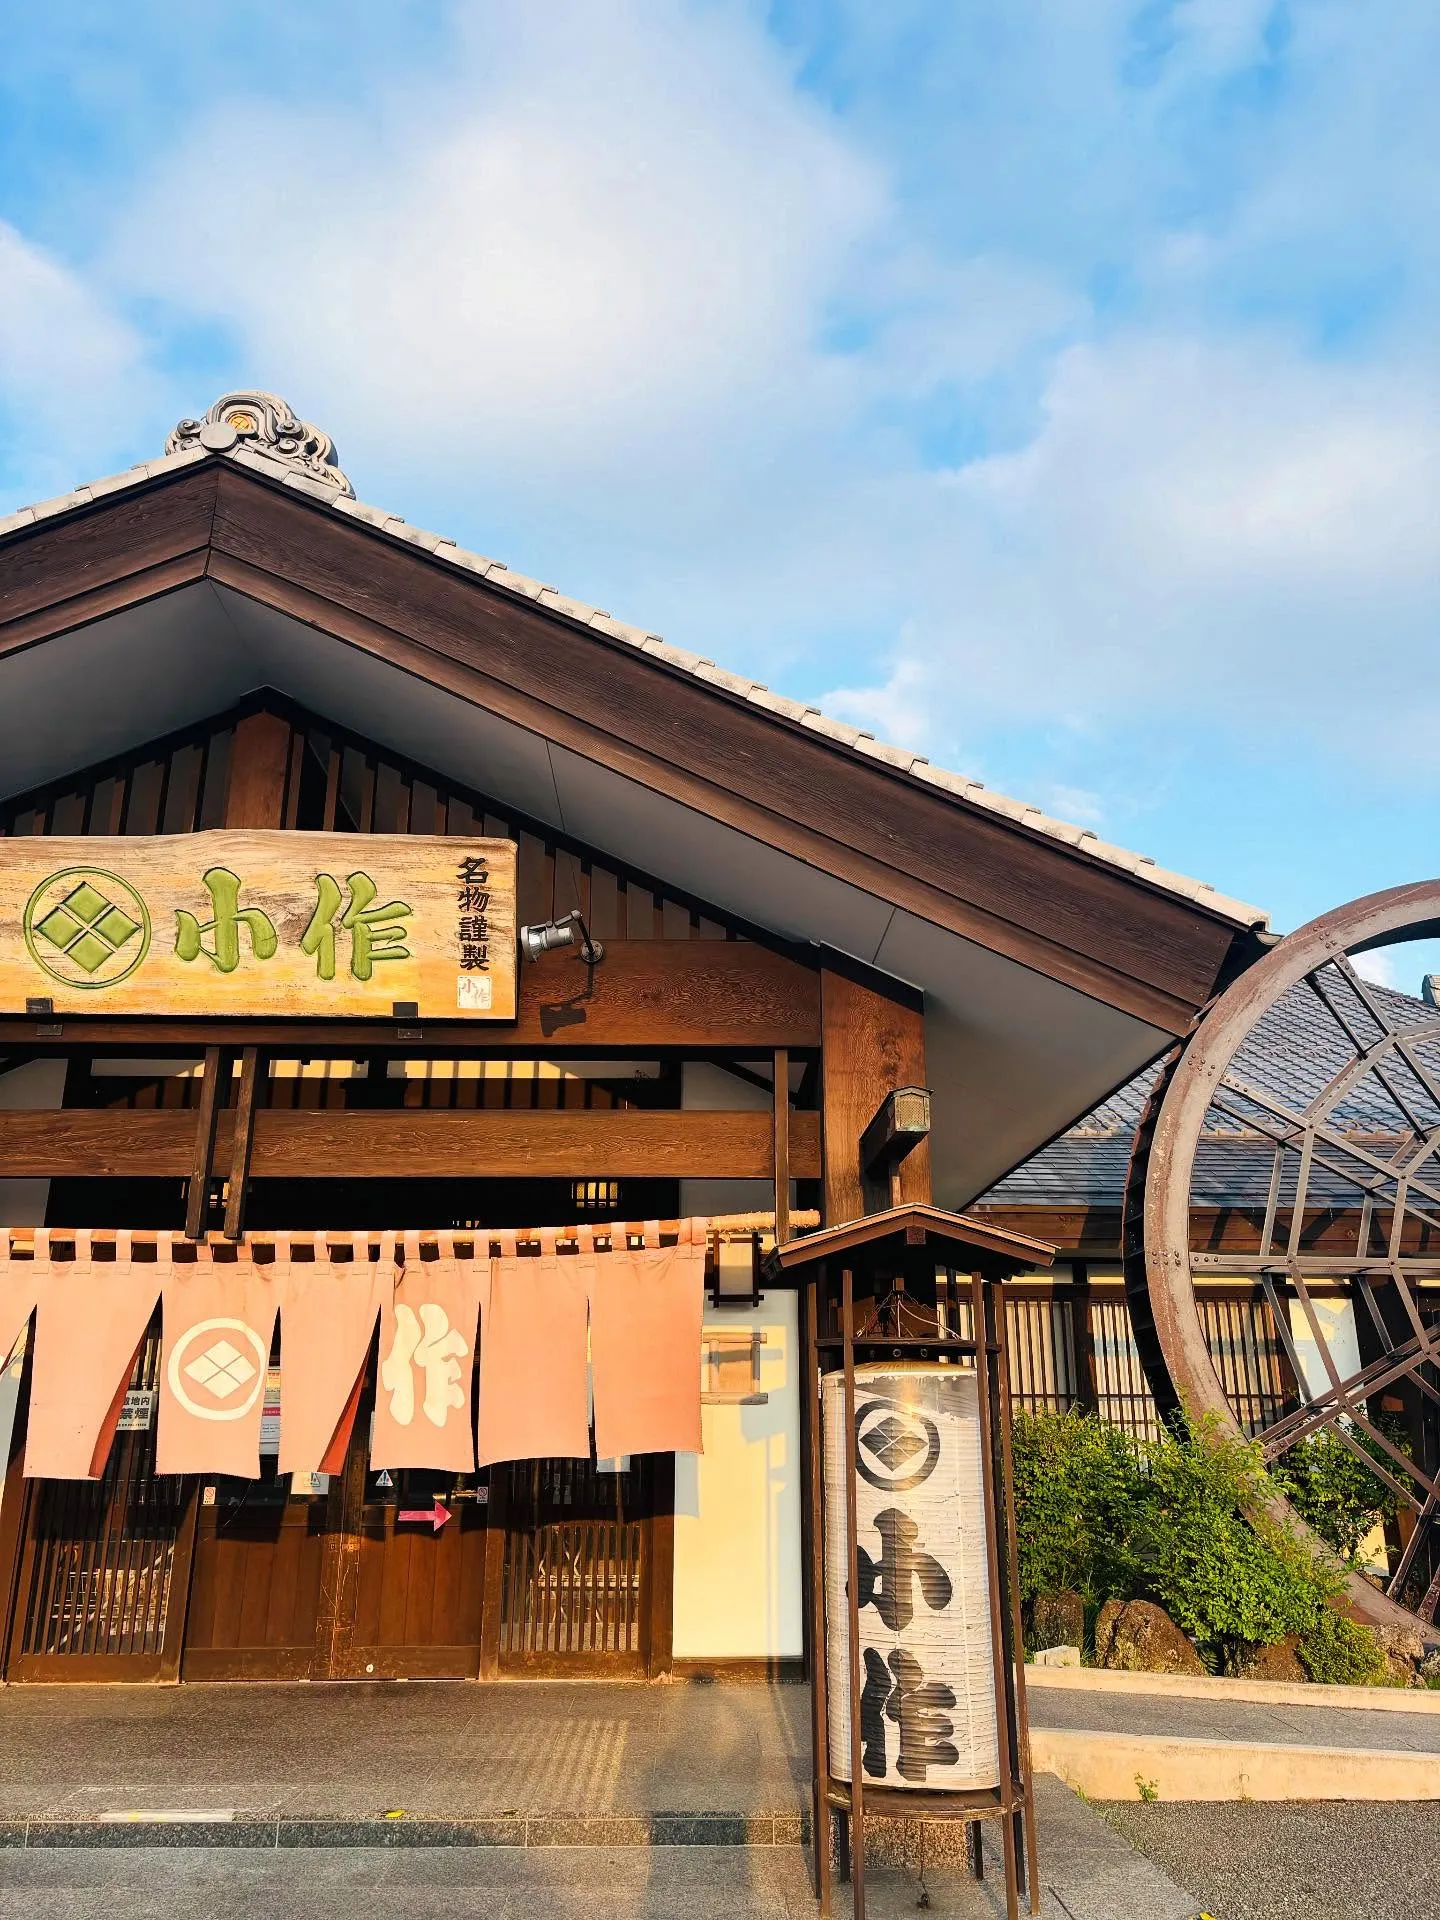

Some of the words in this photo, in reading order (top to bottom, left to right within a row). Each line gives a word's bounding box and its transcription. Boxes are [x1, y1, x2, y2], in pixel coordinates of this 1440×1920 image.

[174, 866, 413, 981] 小作
[456, 856, 490, 971] 名物謹製
[120, 1407, 149, 1419] 禁煙
[381, 1303, 469, 1427] 作
[846, 1507, 960, 1782] 小作
